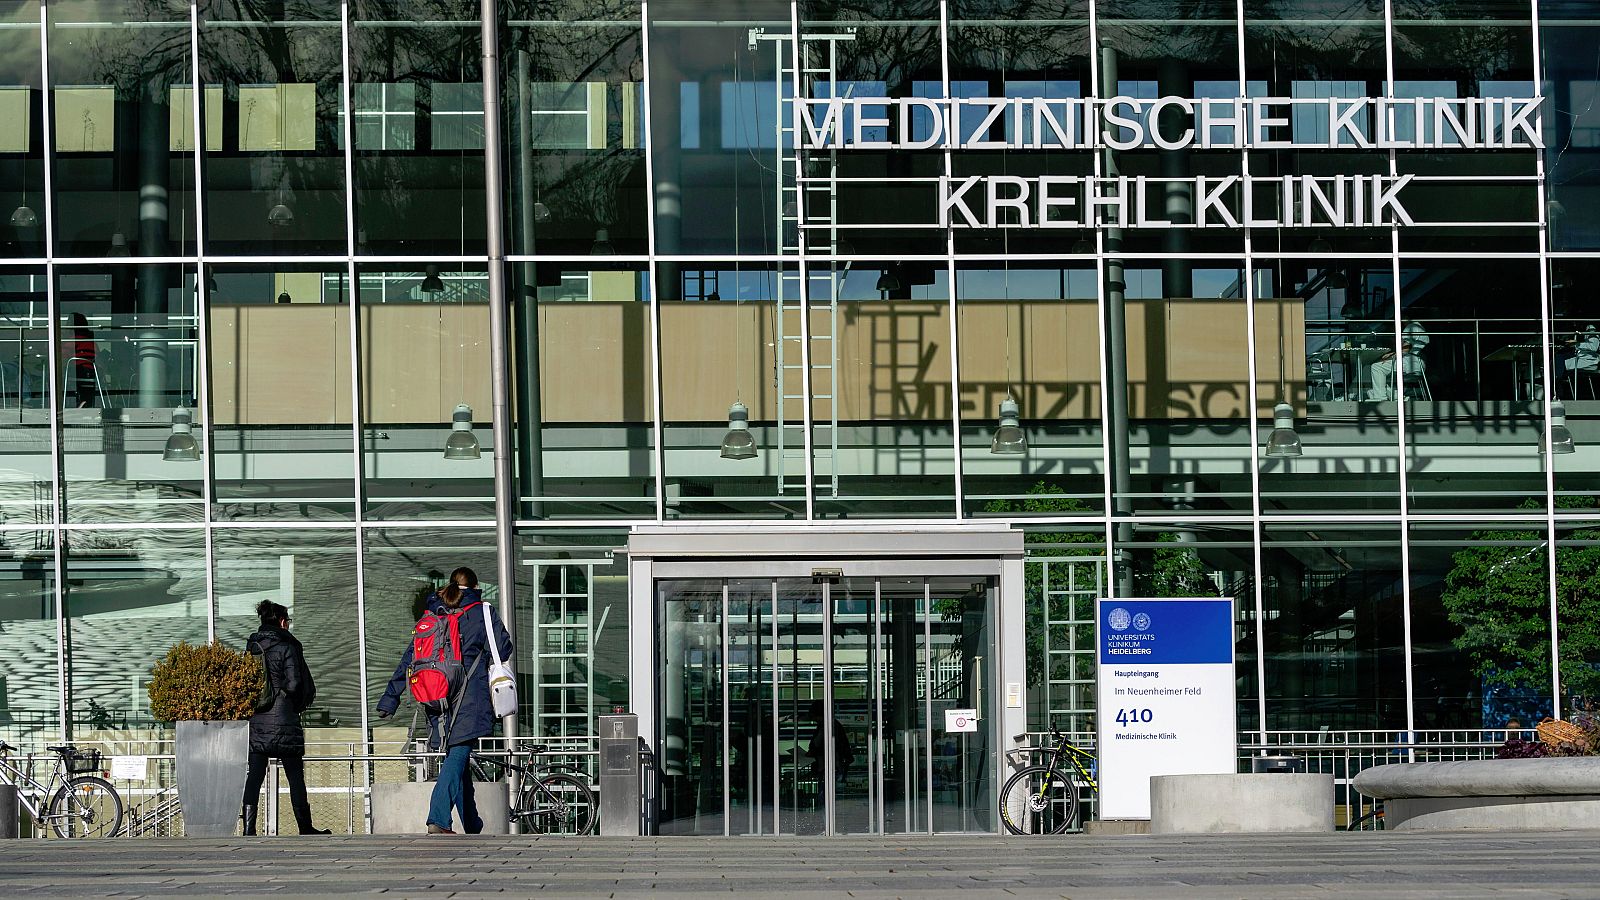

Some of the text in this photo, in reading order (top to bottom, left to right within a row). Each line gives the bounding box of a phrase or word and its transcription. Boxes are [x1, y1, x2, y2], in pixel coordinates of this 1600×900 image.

[793, 96, 1545, 149] MEDIZINISCHE KLINIK
[938, 174, 1416, 229] KREHL KLINIK
[1114, 670, 1160, 678] Haupteingang
[1114, 687, 1202, 695] Im Neuenheimer Feld
[1115, 708, 1153, 728] 410
